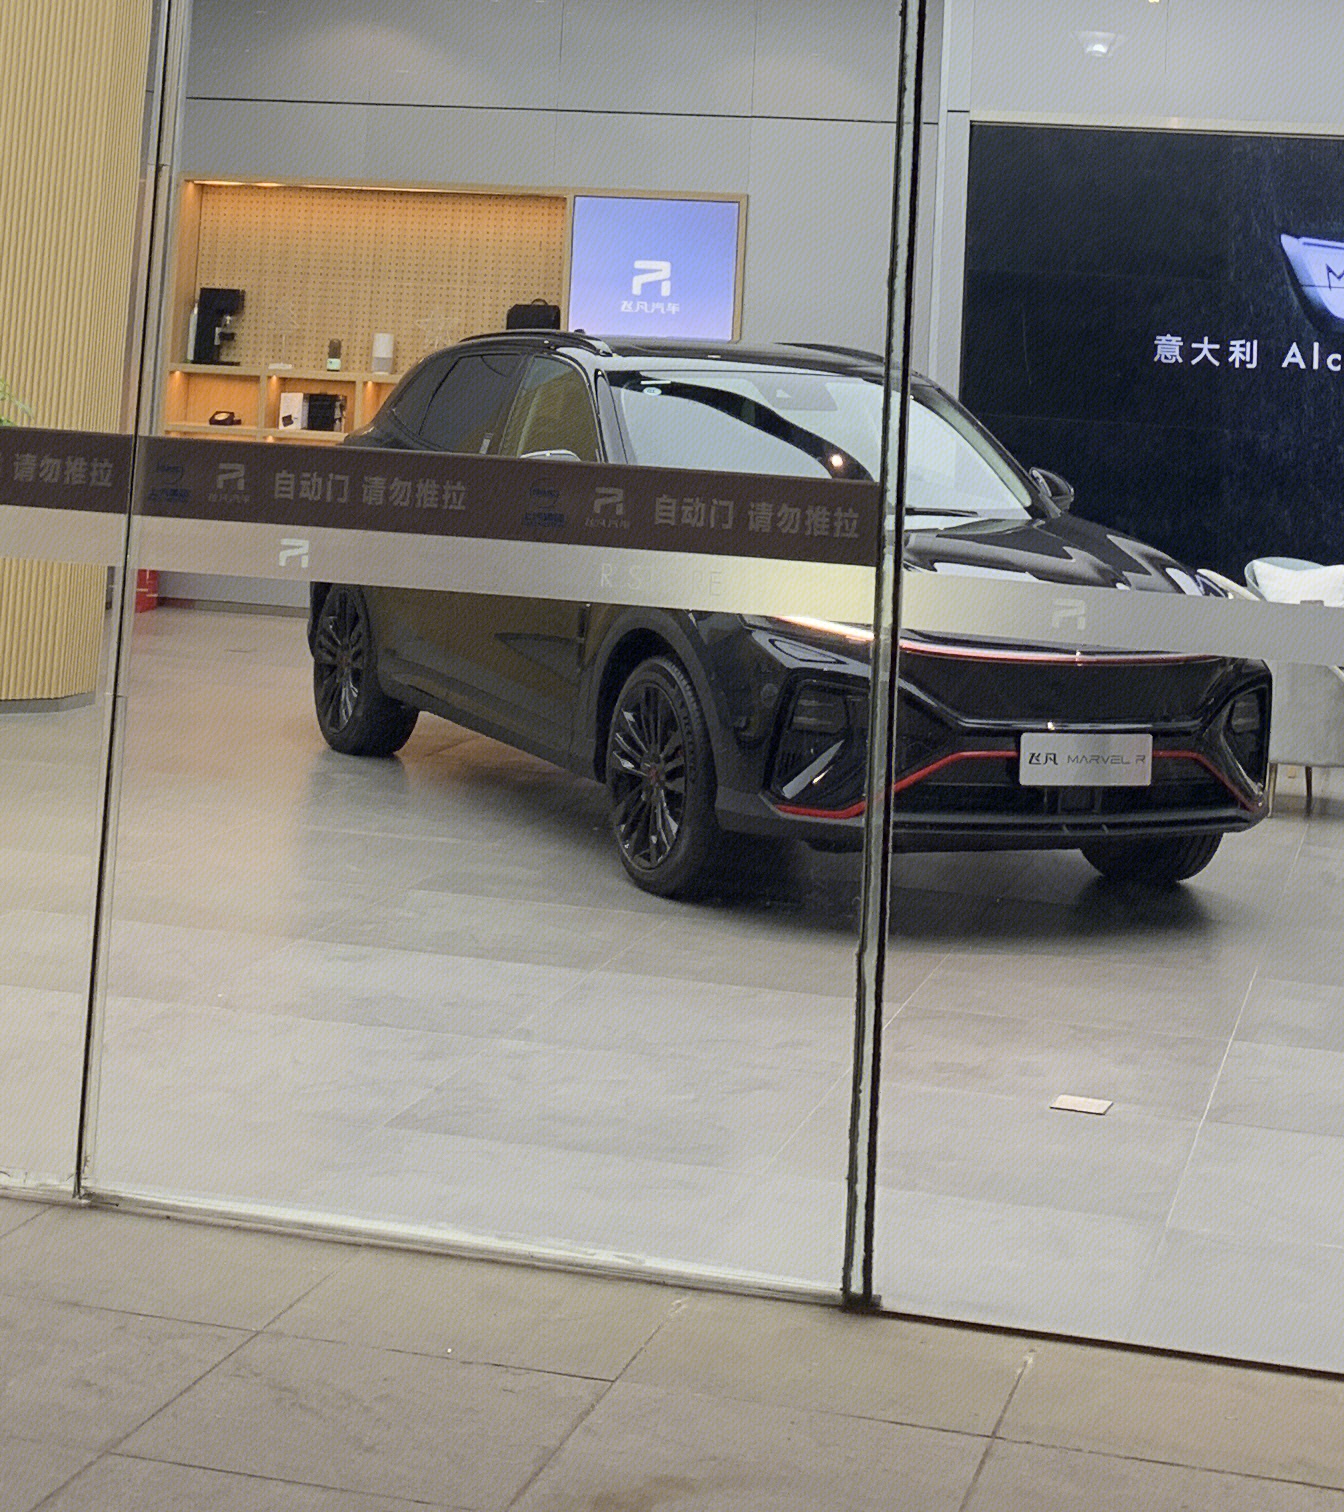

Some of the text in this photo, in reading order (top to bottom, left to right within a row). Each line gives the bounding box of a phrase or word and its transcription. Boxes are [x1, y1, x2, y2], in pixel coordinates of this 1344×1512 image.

[620, 300, 680, 315] 飞凡汽车
[1153, 333, 1258, 371] 意大利
[13, 453, 113, 487] 请勿推拉
[273, 469, 467, 511] 自动门 请勿推拉
[654, 494, 859, 539] 自动门 请勿推拉
[1028, 752, 1146, 766] 飞凡 MARVEL R
